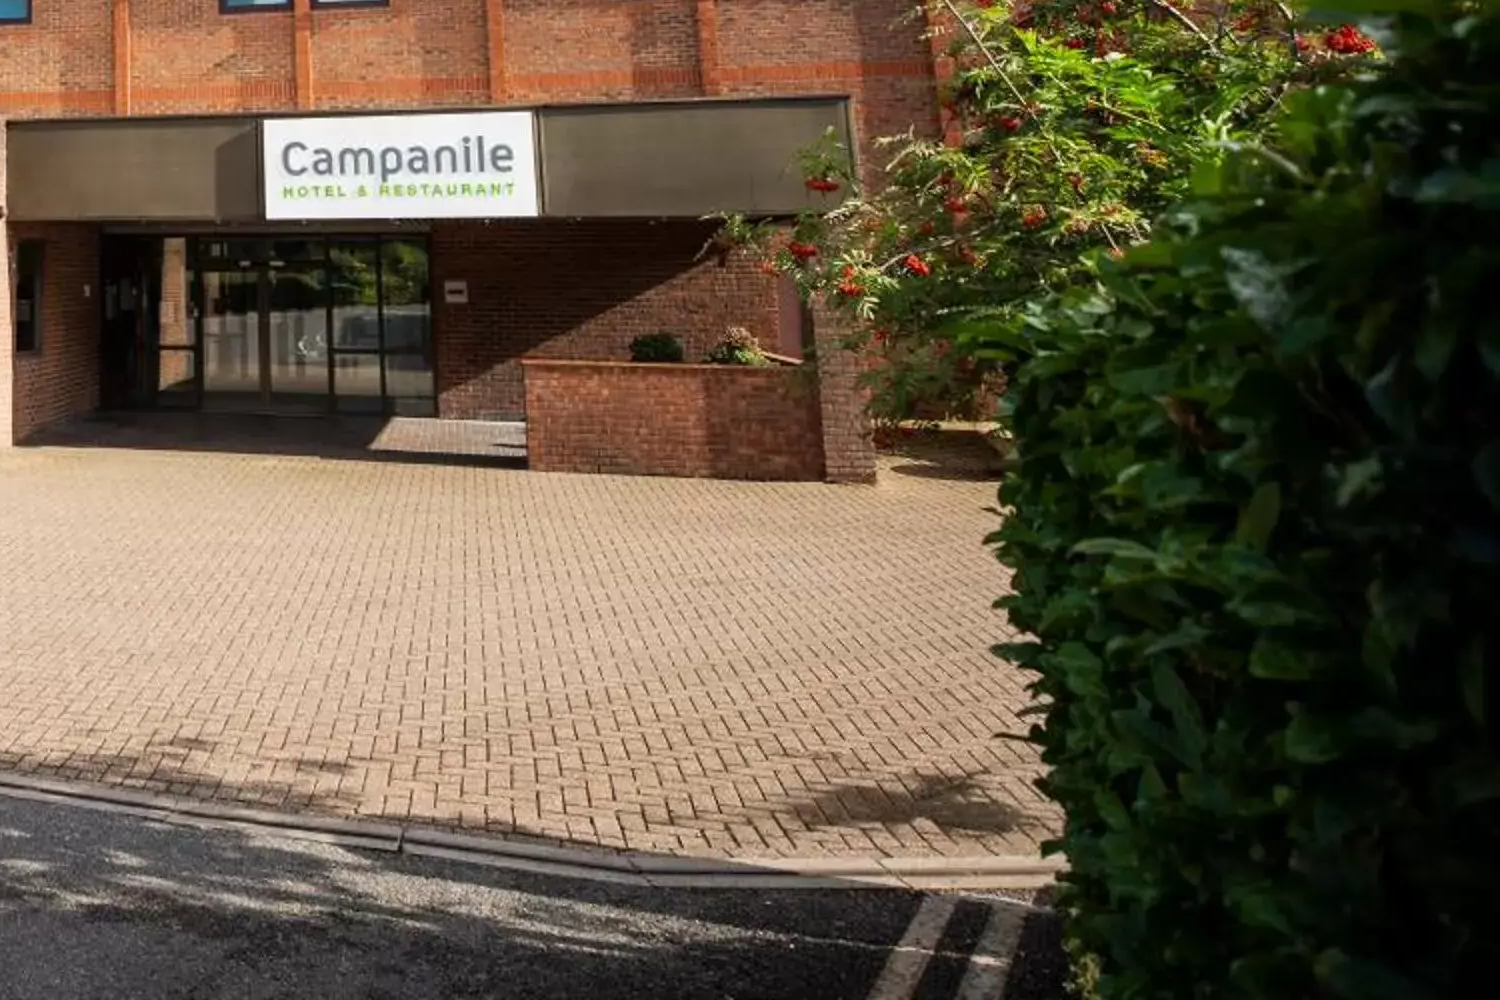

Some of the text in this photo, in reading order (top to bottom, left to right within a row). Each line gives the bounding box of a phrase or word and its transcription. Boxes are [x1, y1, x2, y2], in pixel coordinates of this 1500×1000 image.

[282, 135, 515, 182] Campanile
[283, 185, 346, 198] HOTEL
[379, 182, 515, 198] RESTAURANT
